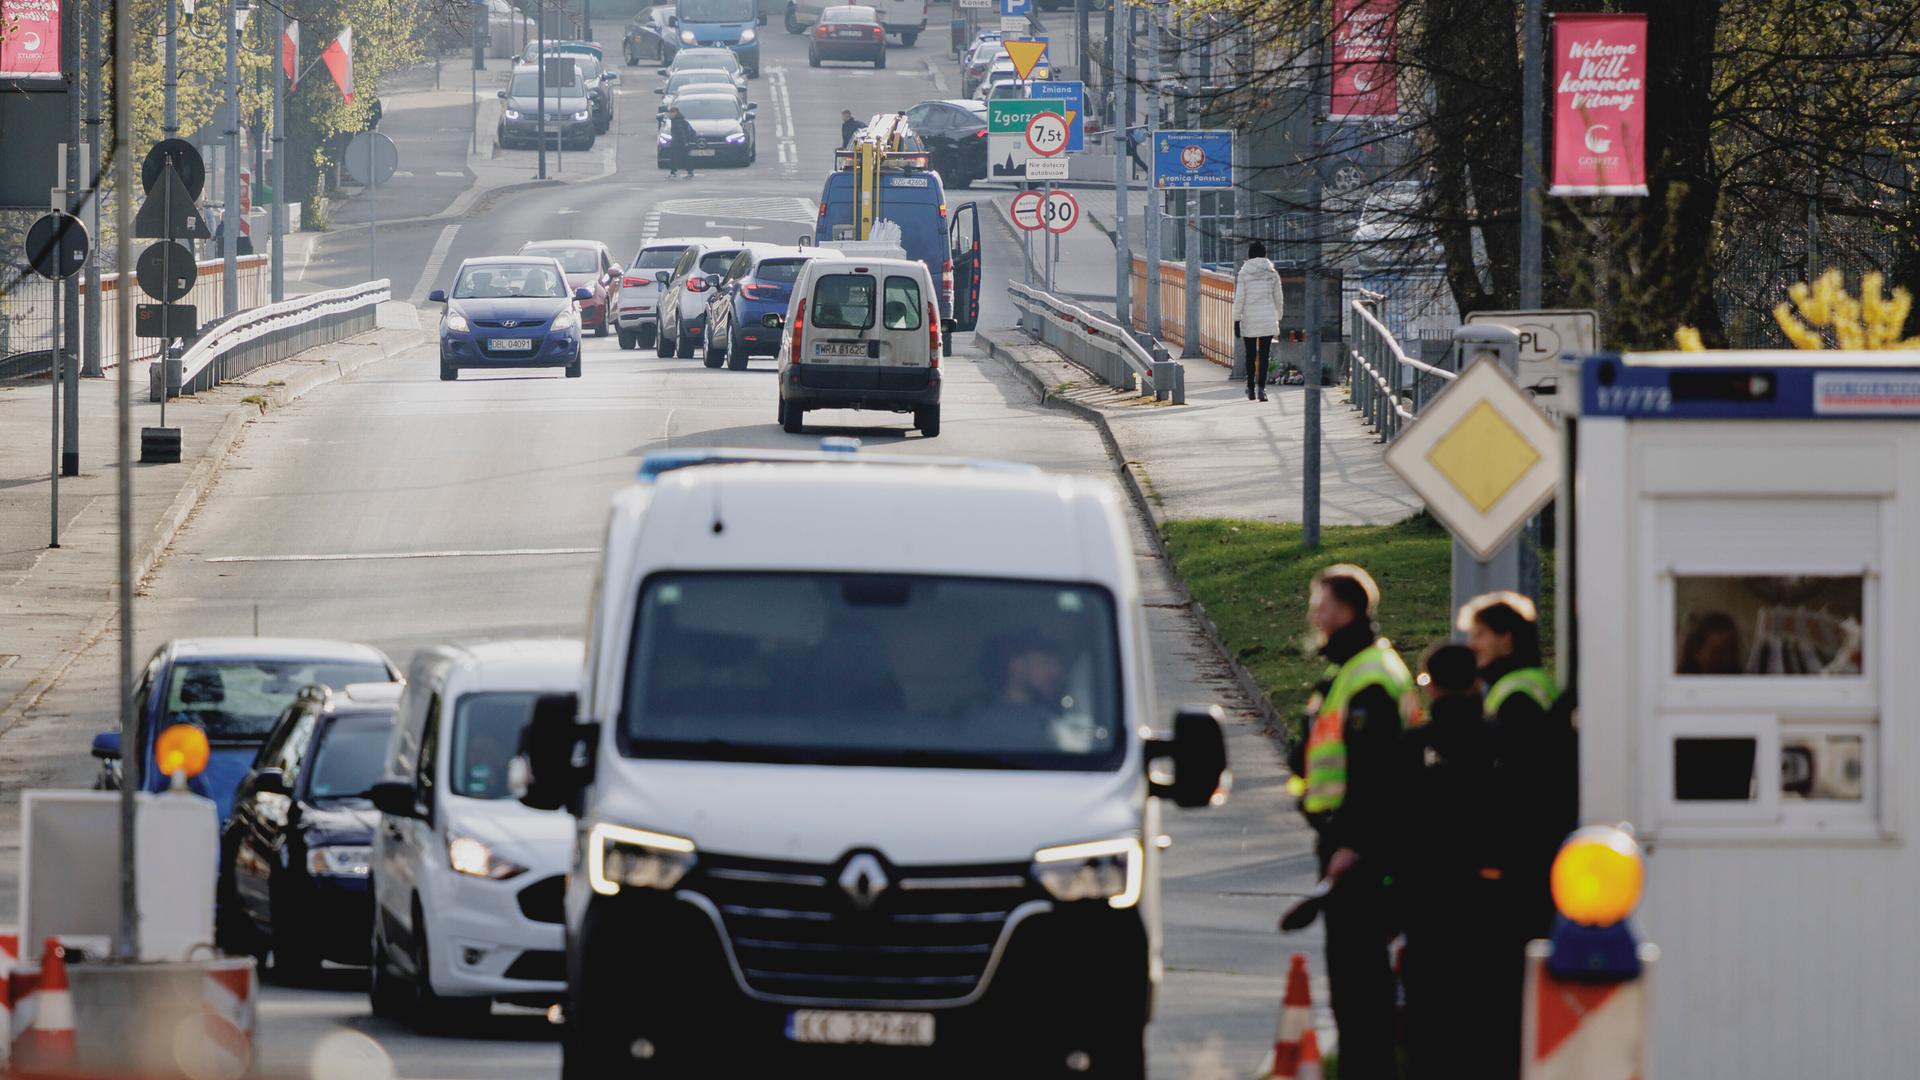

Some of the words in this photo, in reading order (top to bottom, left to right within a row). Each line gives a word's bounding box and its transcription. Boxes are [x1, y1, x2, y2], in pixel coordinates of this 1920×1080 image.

[1569, 38, 1637, 58] Welcome
[1578, 56, 1630, 79] Will-
[1042, 86, 1072, 94] Zmiana
[1557, 71, 1642, 93] kommen
[1571, 92, 1634, 111] Witamy
[1034, 125, 1062, 144] 7,5t
[1166, 174, 1192, 182] ranica
[820, 344, 839, 354] WRA
[1519, 332, 1547, 353] PL
